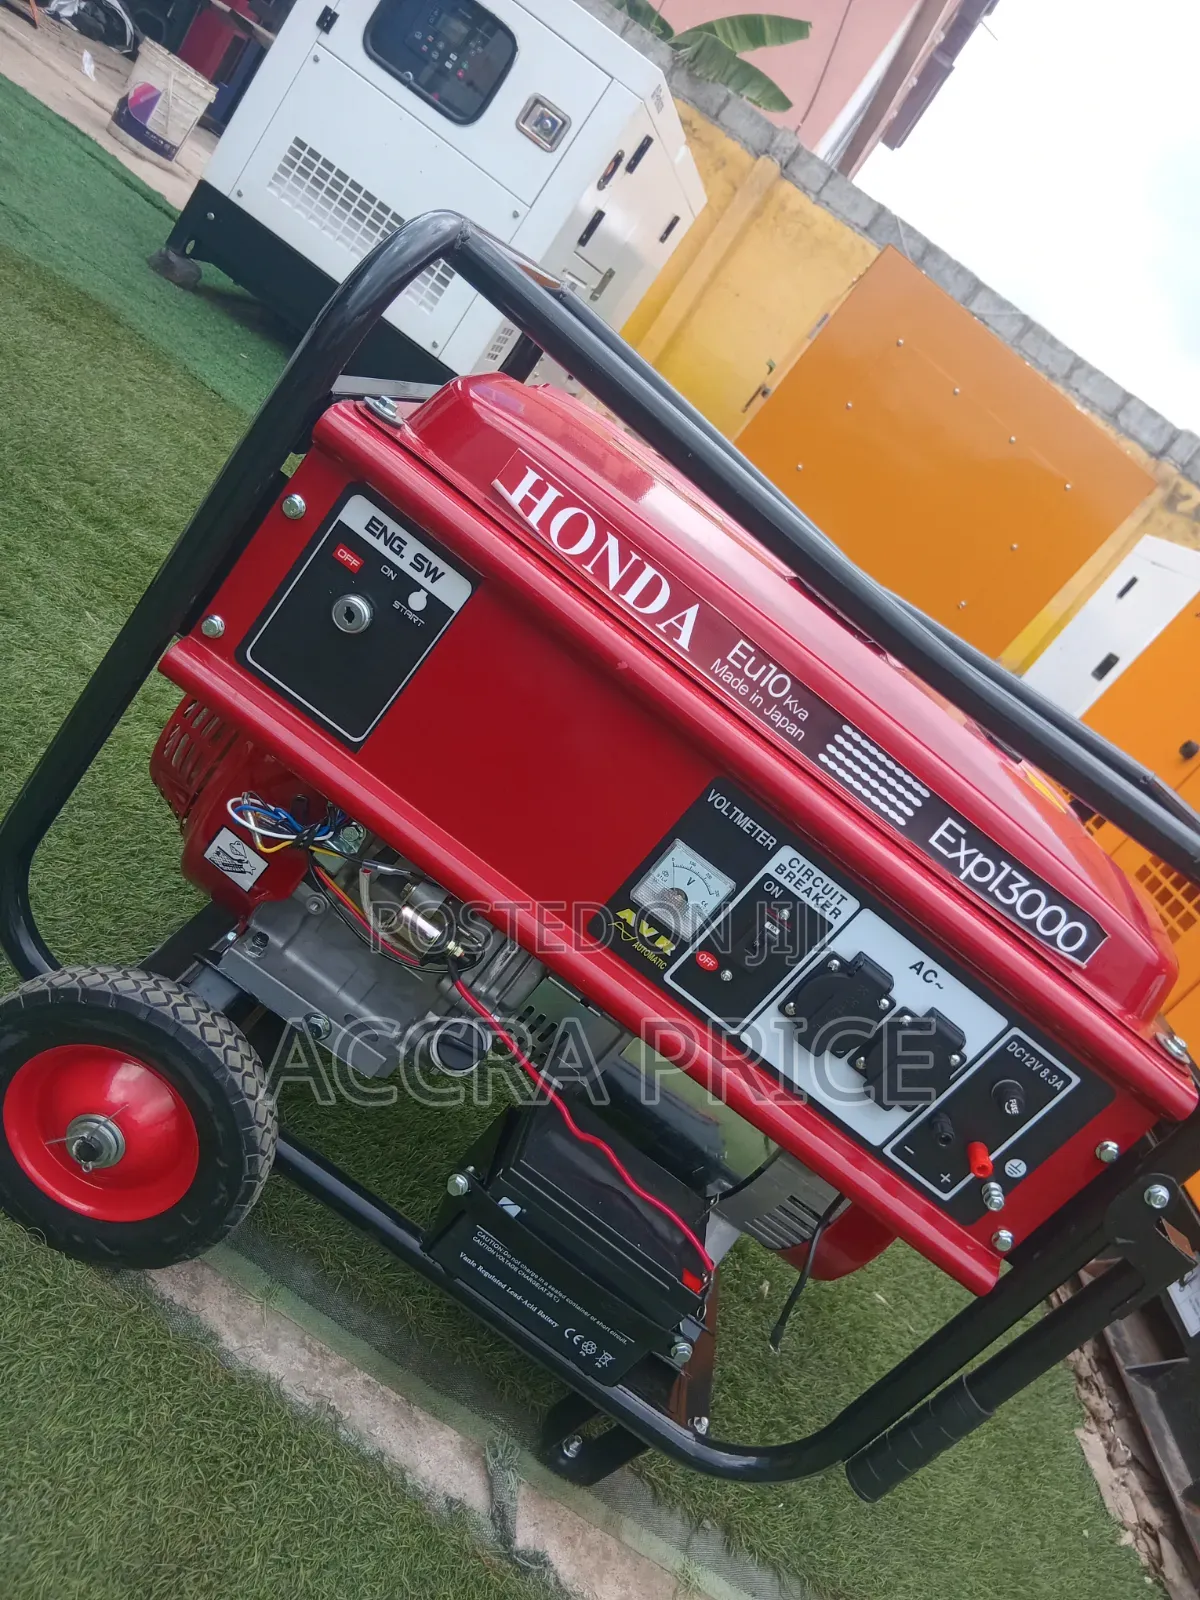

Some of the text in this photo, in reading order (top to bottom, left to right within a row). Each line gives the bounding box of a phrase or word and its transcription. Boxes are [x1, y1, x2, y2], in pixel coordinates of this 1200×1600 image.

[337, 548, 361, 568] OFF
[364, 515, 446, 585] ENG. SW
[380, 564, 398, 581] ON
[509, 465, 700, 652] HONDA
[392, 600, 425, 628] START
[710, 658, 805, 742] Made in Japan
[707, 788, 777, 851] VOLTMETER
[687, 877, 696, 886] V
[763, 880, 783, 899] ON
[774, 863, 842, 920] BREAKER
[788, 857, 848, 905] CIRCUIT
[928, 816, 1088, 953] Exp13000
[615, 908, 676, 957] AVR
[632, 941, 667, 970] AUTOMATIC
[698, 953, 716, 968] OFF
[1006, 1041, 1065, 1091] DC12V 8.3A
[1009, 1098, 1019, 1115] FUSE
[472, 1236, 496, 1255] CAUTION
[495, 1252, 518, 1272] VOLTAGE
[477, 1265, 507, 1289] Regulated
[506, 1286, 538, 1312] Lead-Acid
[537, 1309, 559, 1328] Battery
[511, 1256, 521, 1266] not
[520, 1263, 539, 1279] charge
[538, 1276, 545, 1284] in
[548, 1283, 567, 1299] sealed
[565, 1296, 591, 1317] container
[590, 1314, 598, 1322] or
[596, 1319, 611, 1333] short
